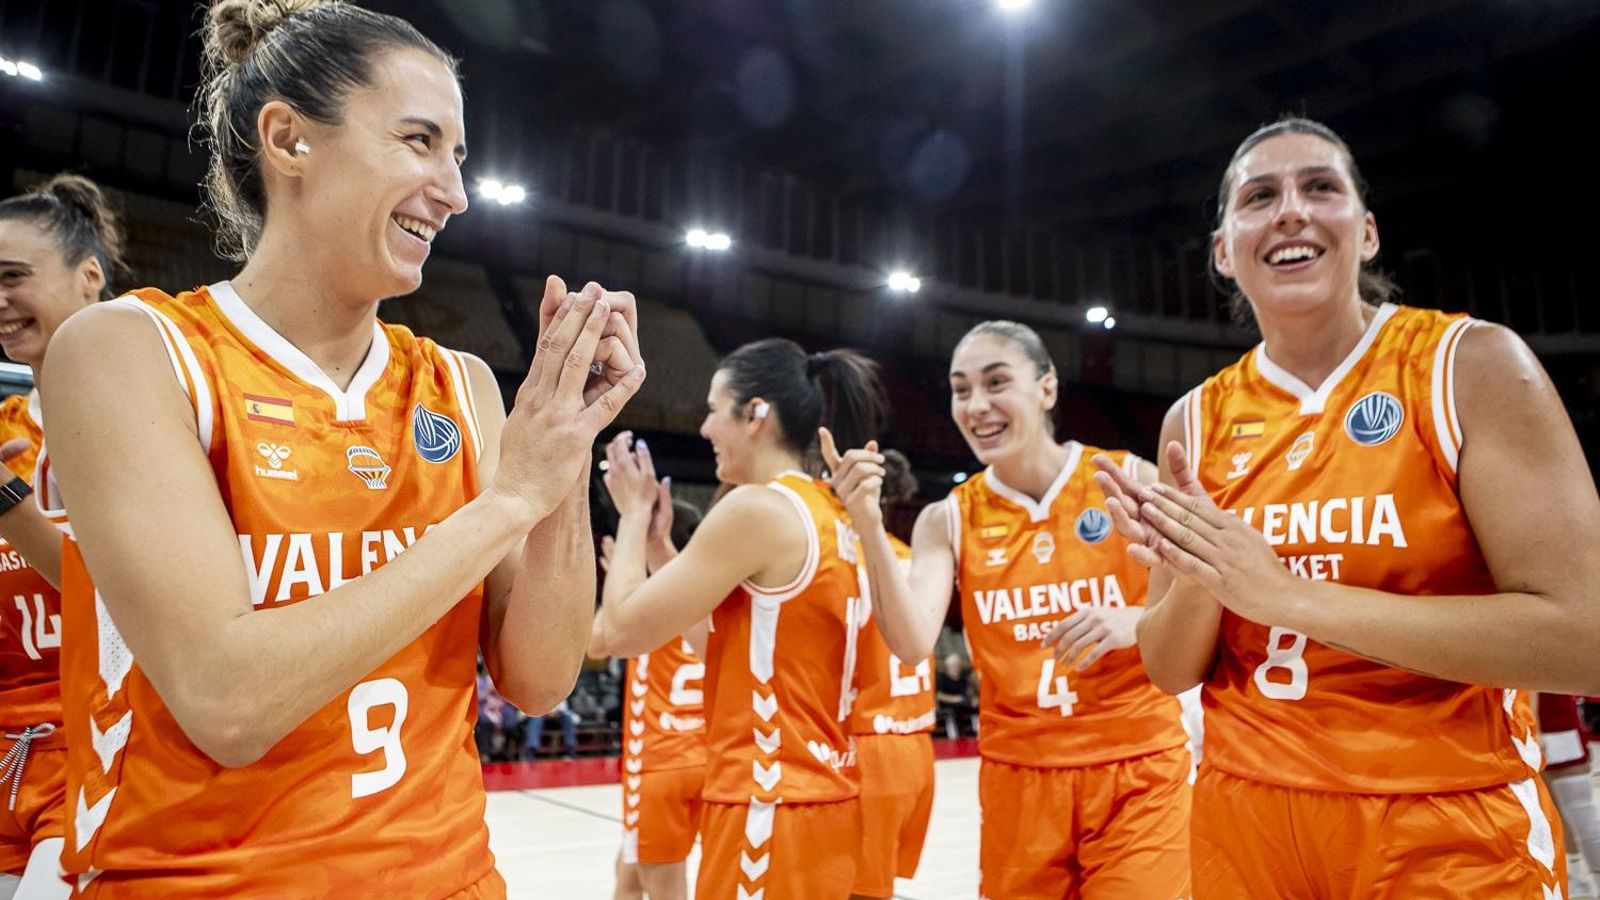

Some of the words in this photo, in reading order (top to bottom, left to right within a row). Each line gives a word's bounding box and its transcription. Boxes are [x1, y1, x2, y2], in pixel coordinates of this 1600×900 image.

[255, 465, 298, 480] hummel
[1222, 494, 1409, 548] ENCIA
[1279, 553, 1344, 581] KET
[973, 574, 1127, 625] VALENCIA
[13, 593, 62, 661] 14
[1013, 620, 1059, 642] BAS
[1037, 658, 1078, 717] 4
[1253, 626, 1309, 701] 8
[347, 677, 409, 799] 9
